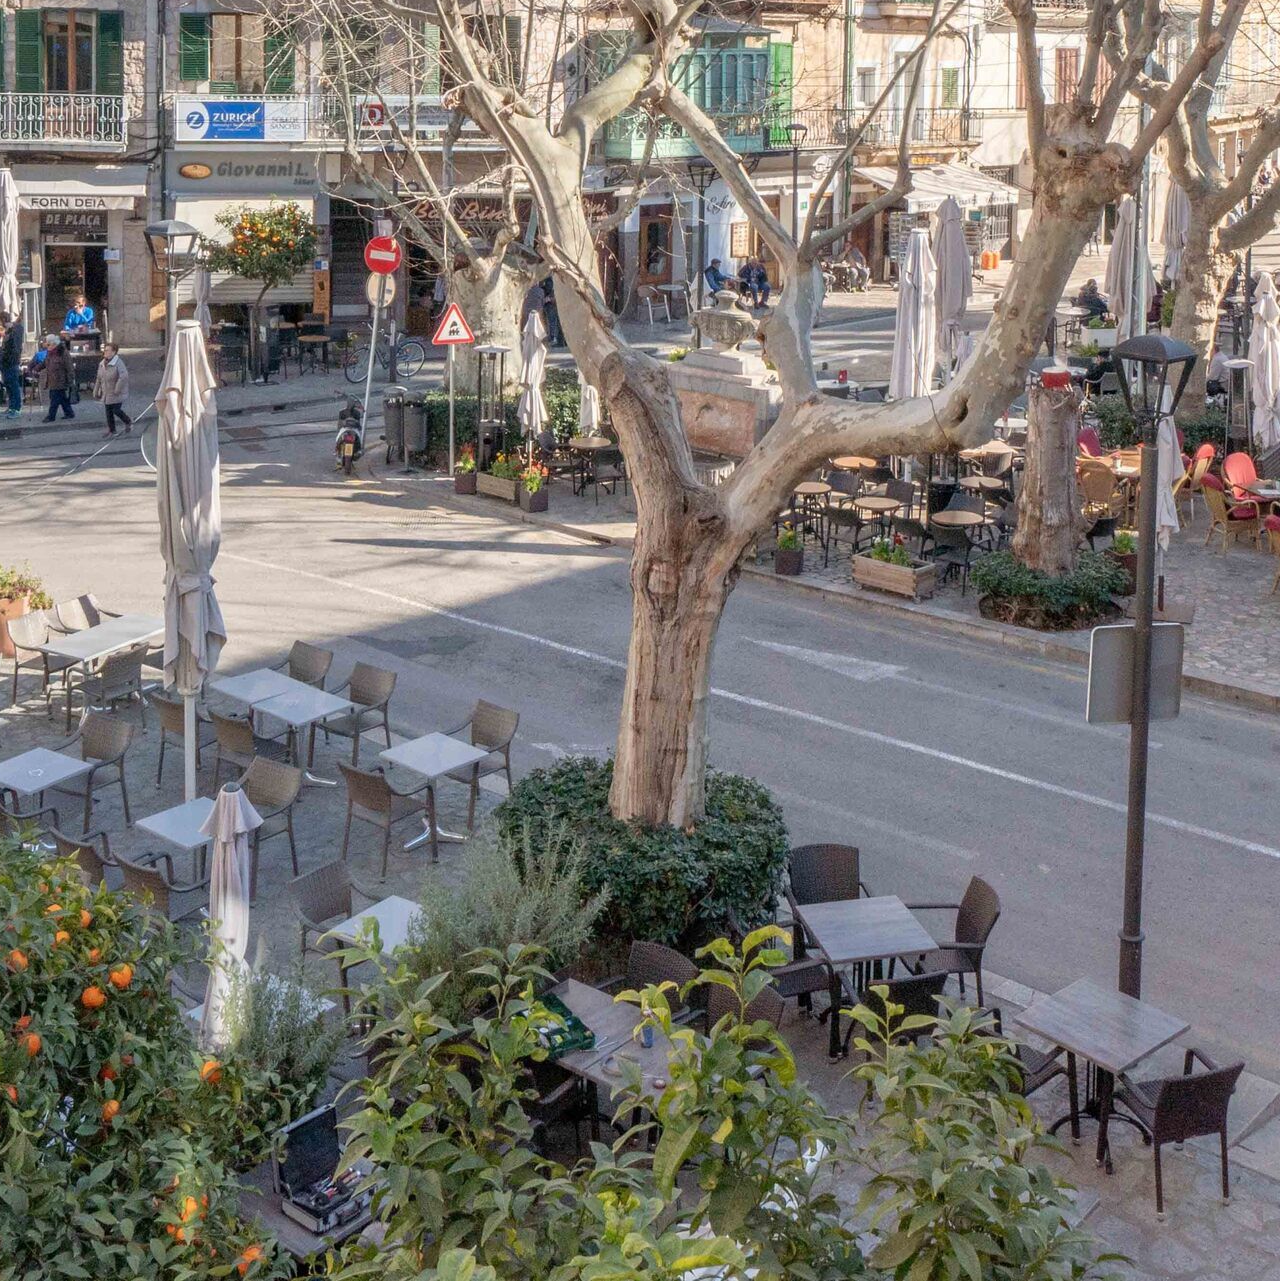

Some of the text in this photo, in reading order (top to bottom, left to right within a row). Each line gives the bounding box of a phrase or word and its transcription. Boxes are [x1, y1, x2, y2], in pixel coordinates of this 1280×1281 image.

[213, 112, 256, 122] ZURICH
[217, 162, 293, 177] Giovanni
[31, 197, 69, 207] FORN
[46, 214, 60, 225] DE
